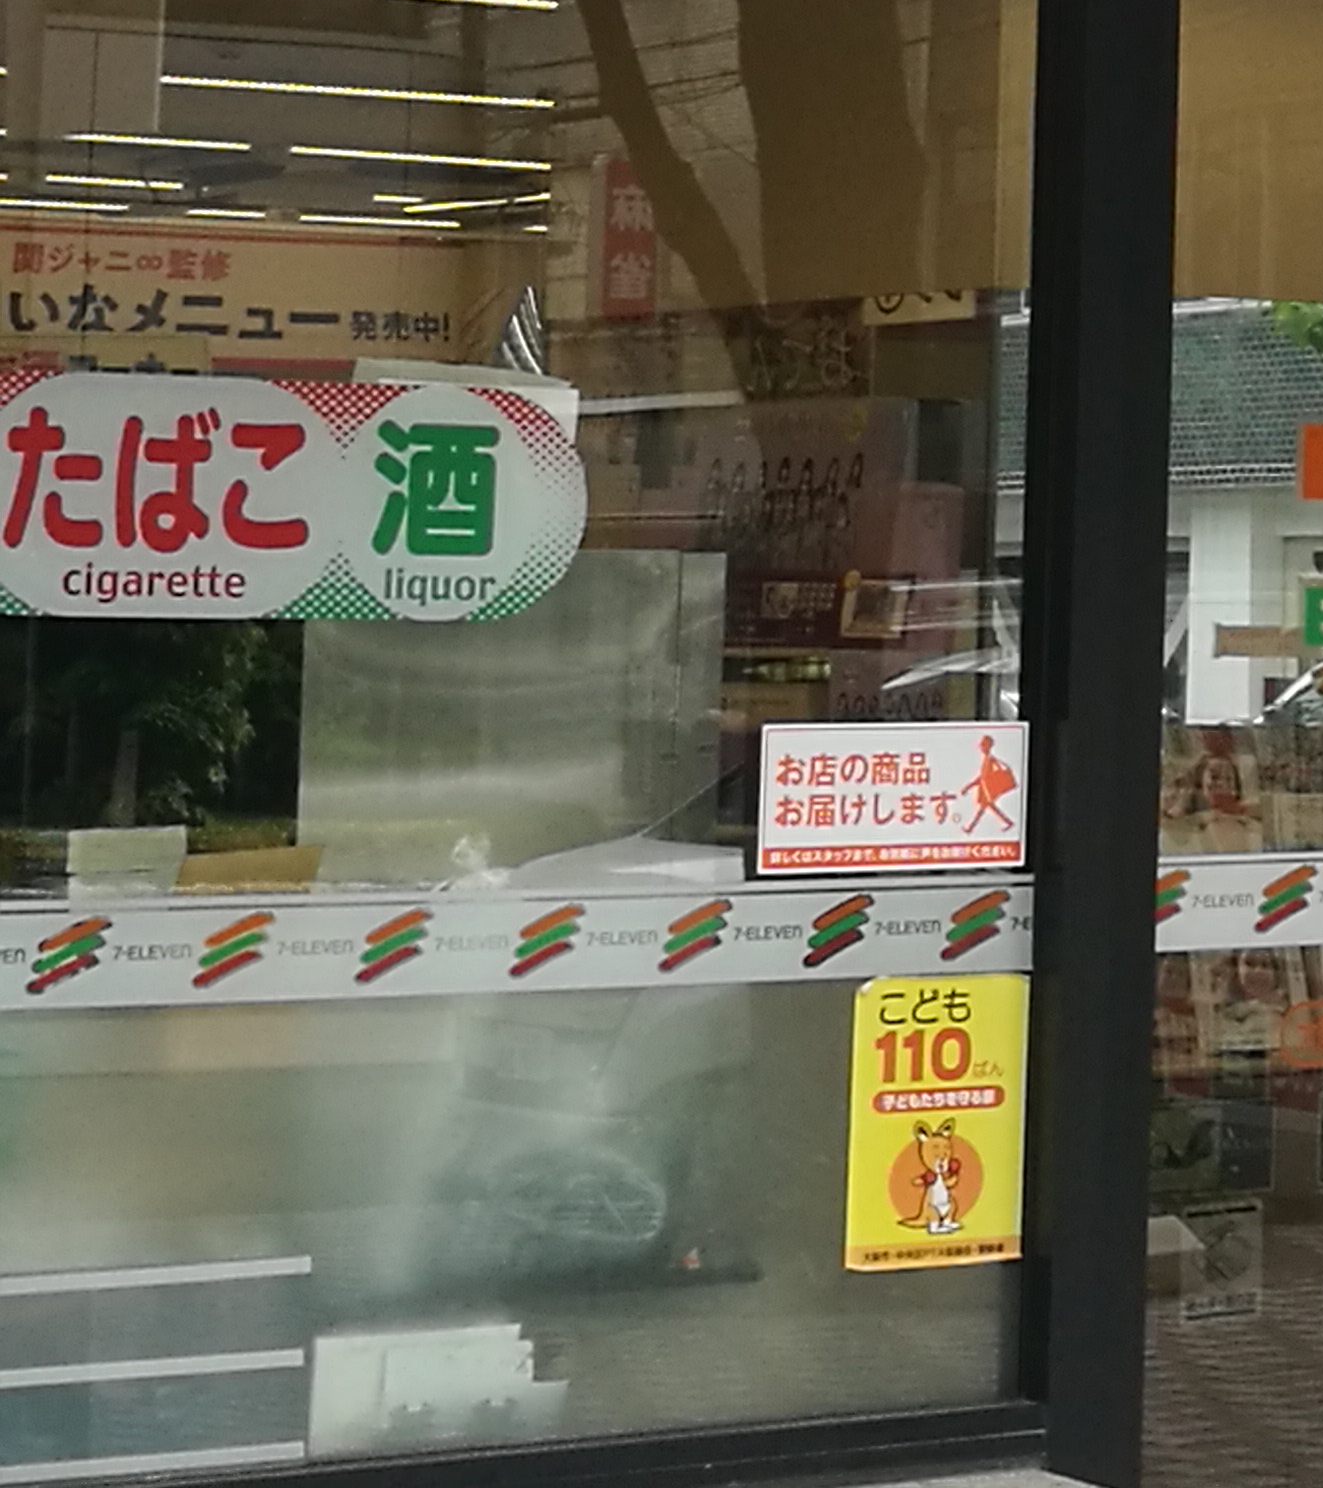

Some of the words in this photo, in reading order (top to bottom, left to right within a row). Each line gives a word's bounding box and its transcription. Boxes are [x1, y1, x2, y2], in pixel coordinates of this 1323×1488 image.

[3, 407, 309, 553] たばこ
[372, 419, 500, 555] 酒
[62, 564, 246, 602] cigarette
[383, 567, 496, 604] liquor
[774, 752, 931, 787] お店の商品
[773, 792, 962, 829] お届けします。
[879, 987, 972, 1025] こども
[875, 1026, 972, 1083] 110
